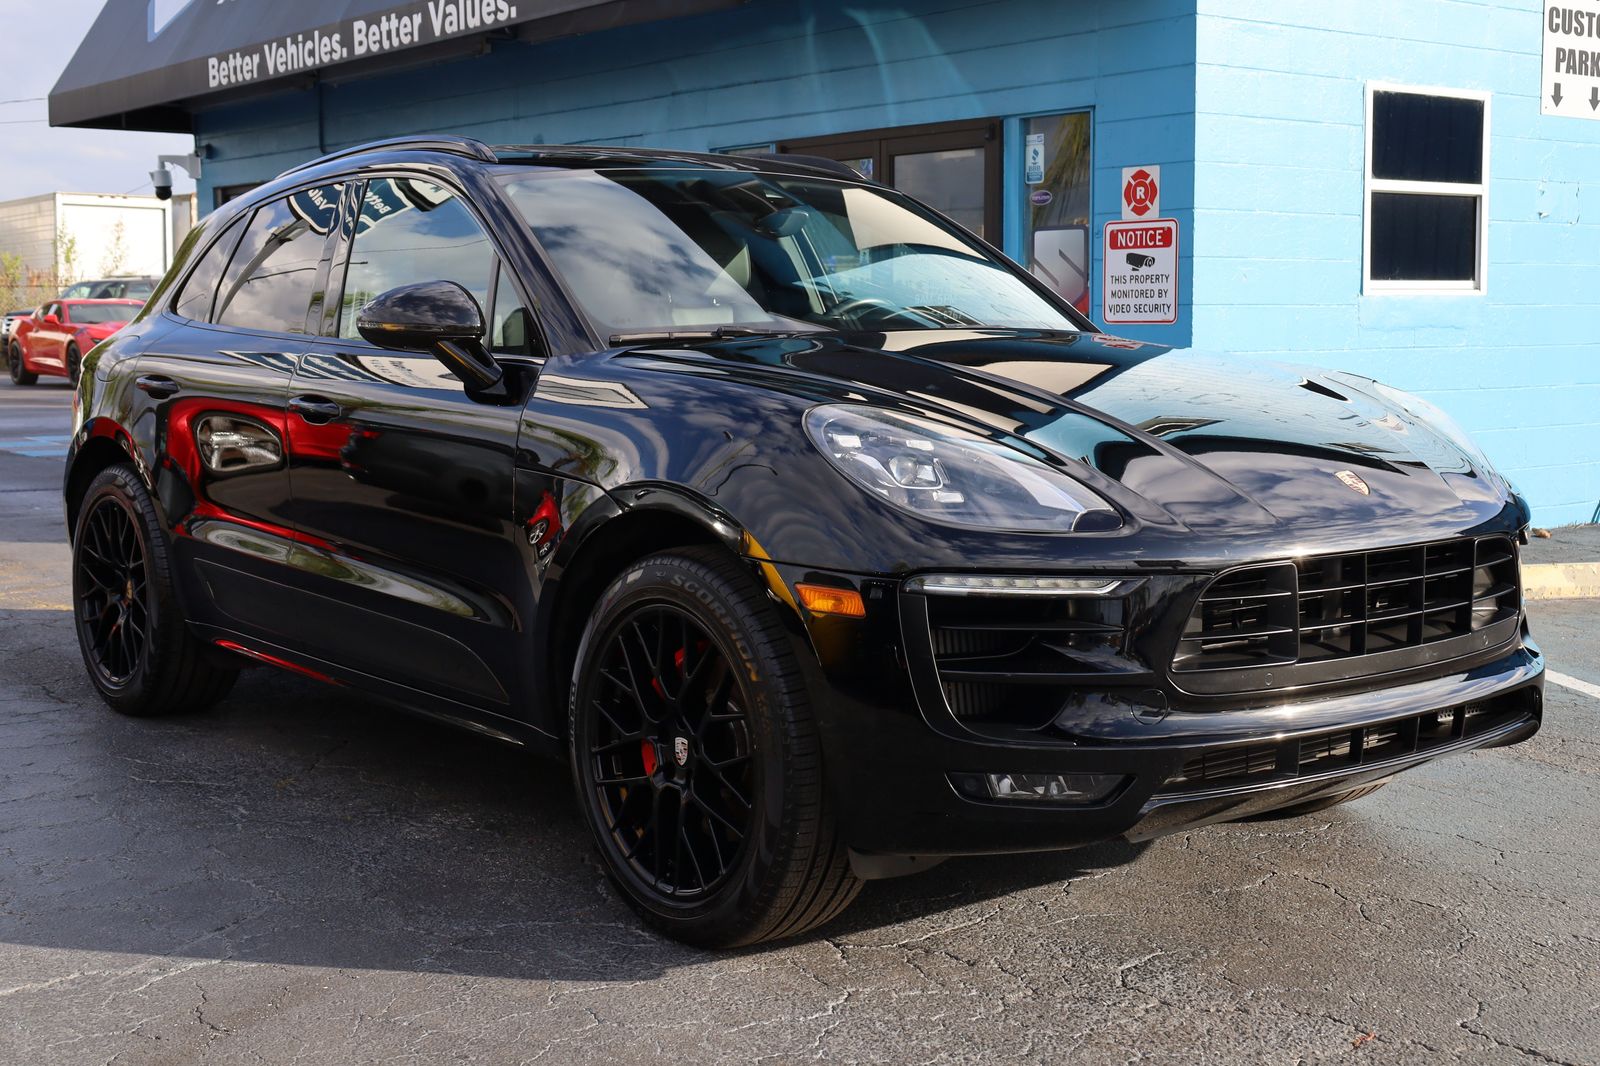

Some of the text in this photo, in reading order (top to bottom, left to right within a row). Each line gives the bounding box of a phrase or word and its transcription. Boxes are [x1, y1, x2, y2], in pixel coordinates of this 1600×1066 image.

[208, 0, 517, 88] Better Vehicles. Better Values.
[1555, 47, 1600, 78] PARK
[1136, 186, 1145, 199] R
[1117, 229, 1164, 247] NOTICE
[1110, 273, 1170, 285] THIS PROPERTY
[1110, 288, 1168, 299] MONITORED BY
[1108, 303, 1172, 314] VIDEO SECURITY
[669, 573, 762, 682] SCORPION
